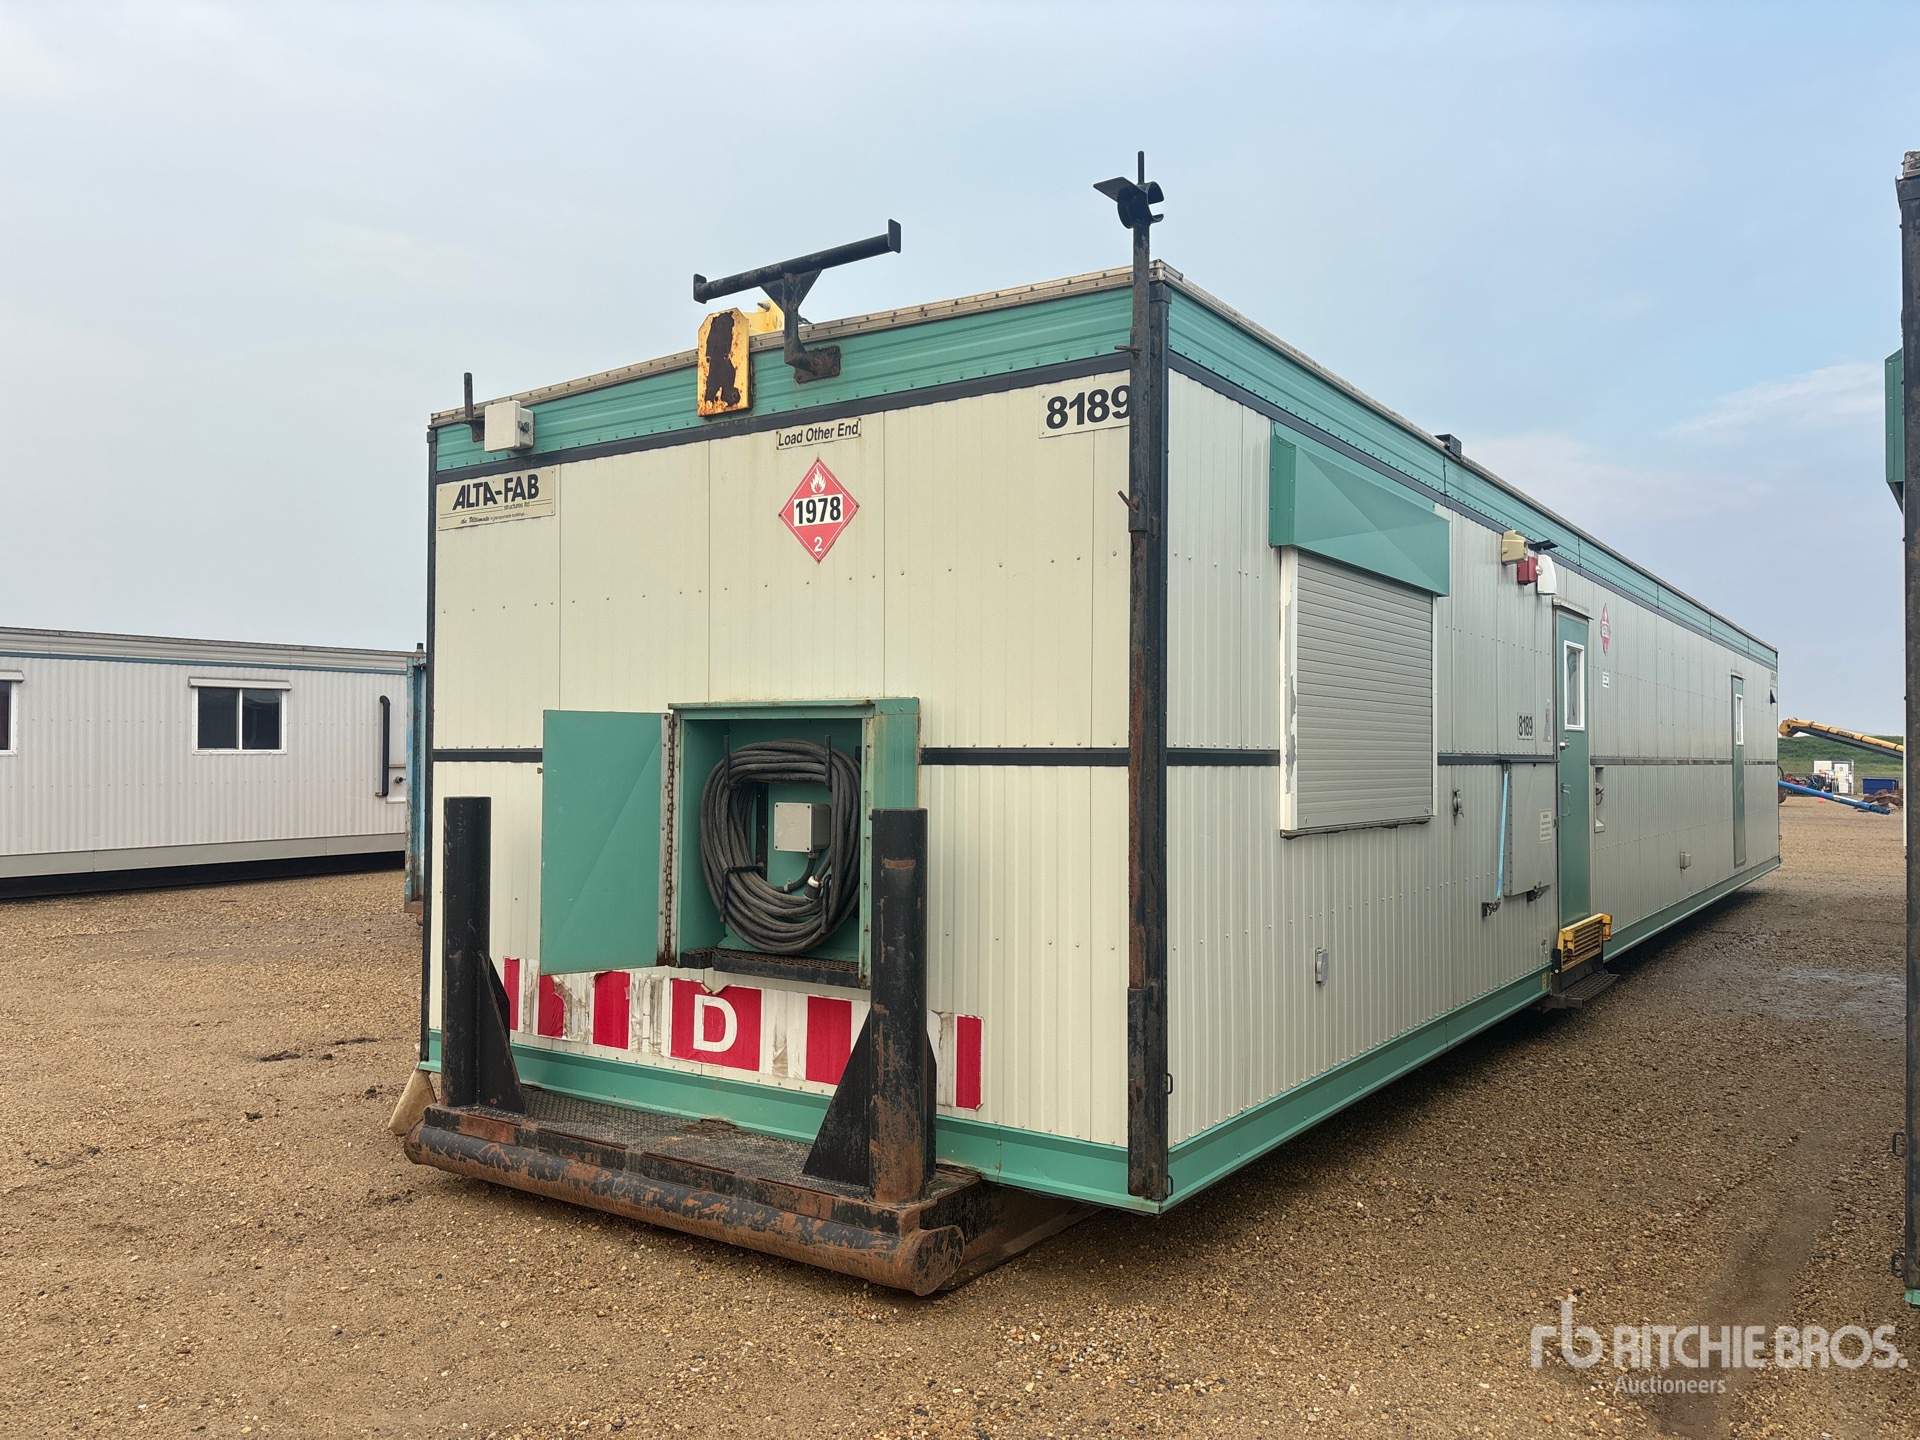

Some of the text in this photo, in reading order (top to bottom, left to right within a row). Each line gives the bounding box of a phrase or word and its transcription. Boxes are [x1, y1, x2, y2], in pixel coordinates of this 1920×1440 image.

[1046, 385, 1130, 429] 8189
[778, 421, 859, 446] Load Other End
[452, 474, 540, 510] ALTA-FAB
[795, 496, 842, 525] 1978
[813, 536, 823, 552] 2
[1518, 715, 1533, 736] 8189
[693, 994, 738, 1053] D
